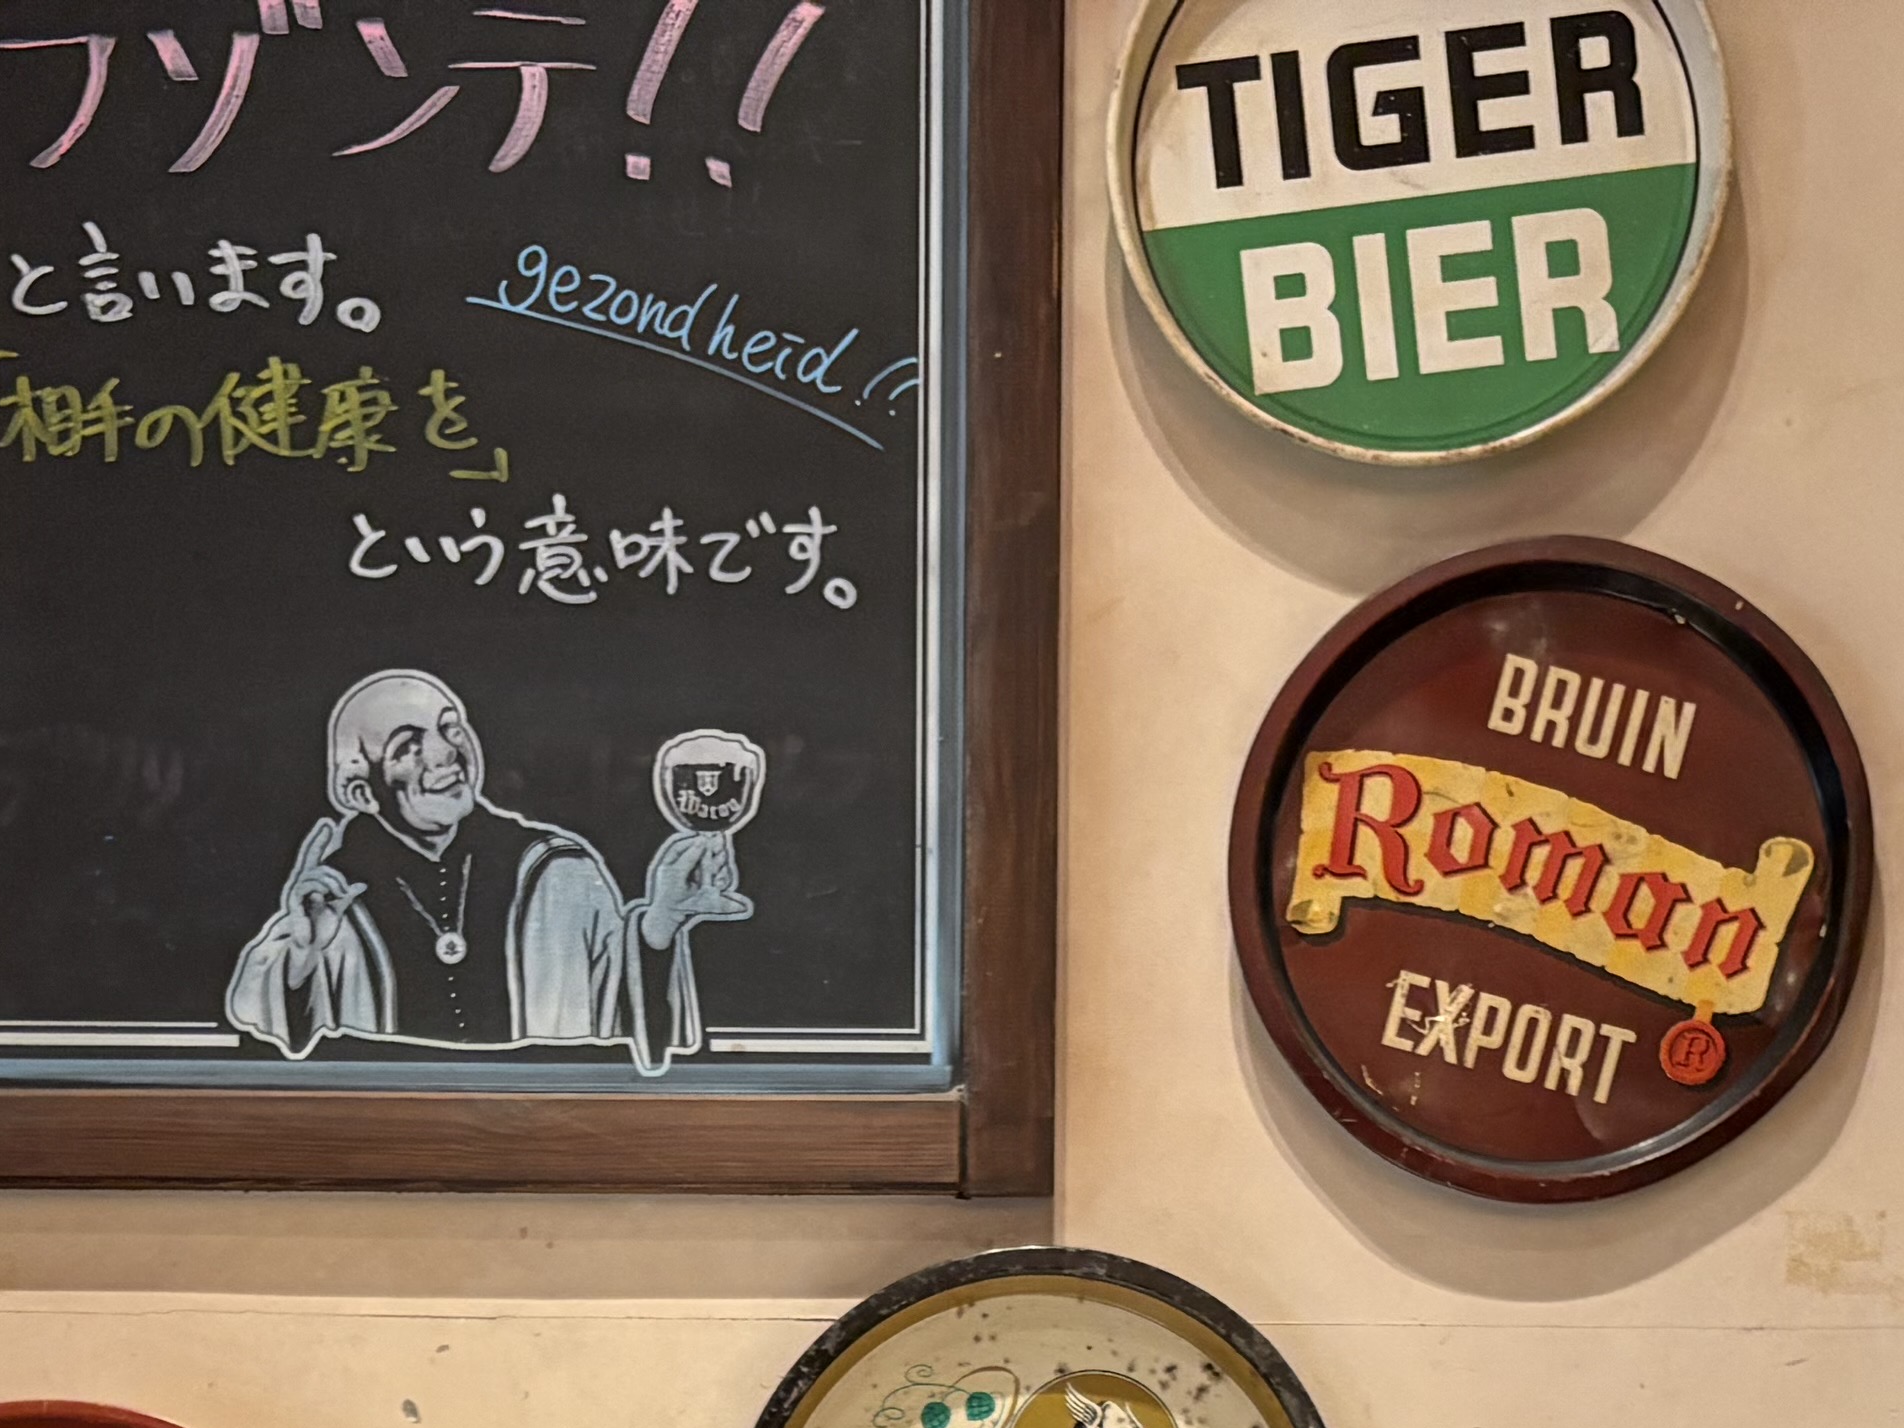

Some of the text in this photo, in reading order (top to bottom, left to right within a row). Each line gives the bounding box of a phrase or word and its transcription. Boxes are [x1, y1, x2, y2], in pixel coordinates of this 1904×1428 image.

[1176, 9, 1645, 190] TIGER
[9, 221, 382, 333] と言います。
[1239, 207, 1620, 396] BIER
[348, 494, 860, 609] という意味です。
[1487, 652, 1697, 780] BRUIN
[1312, 760, 1769, 982] Roman
[1380, 968, 1639, 1104] EXPORT
